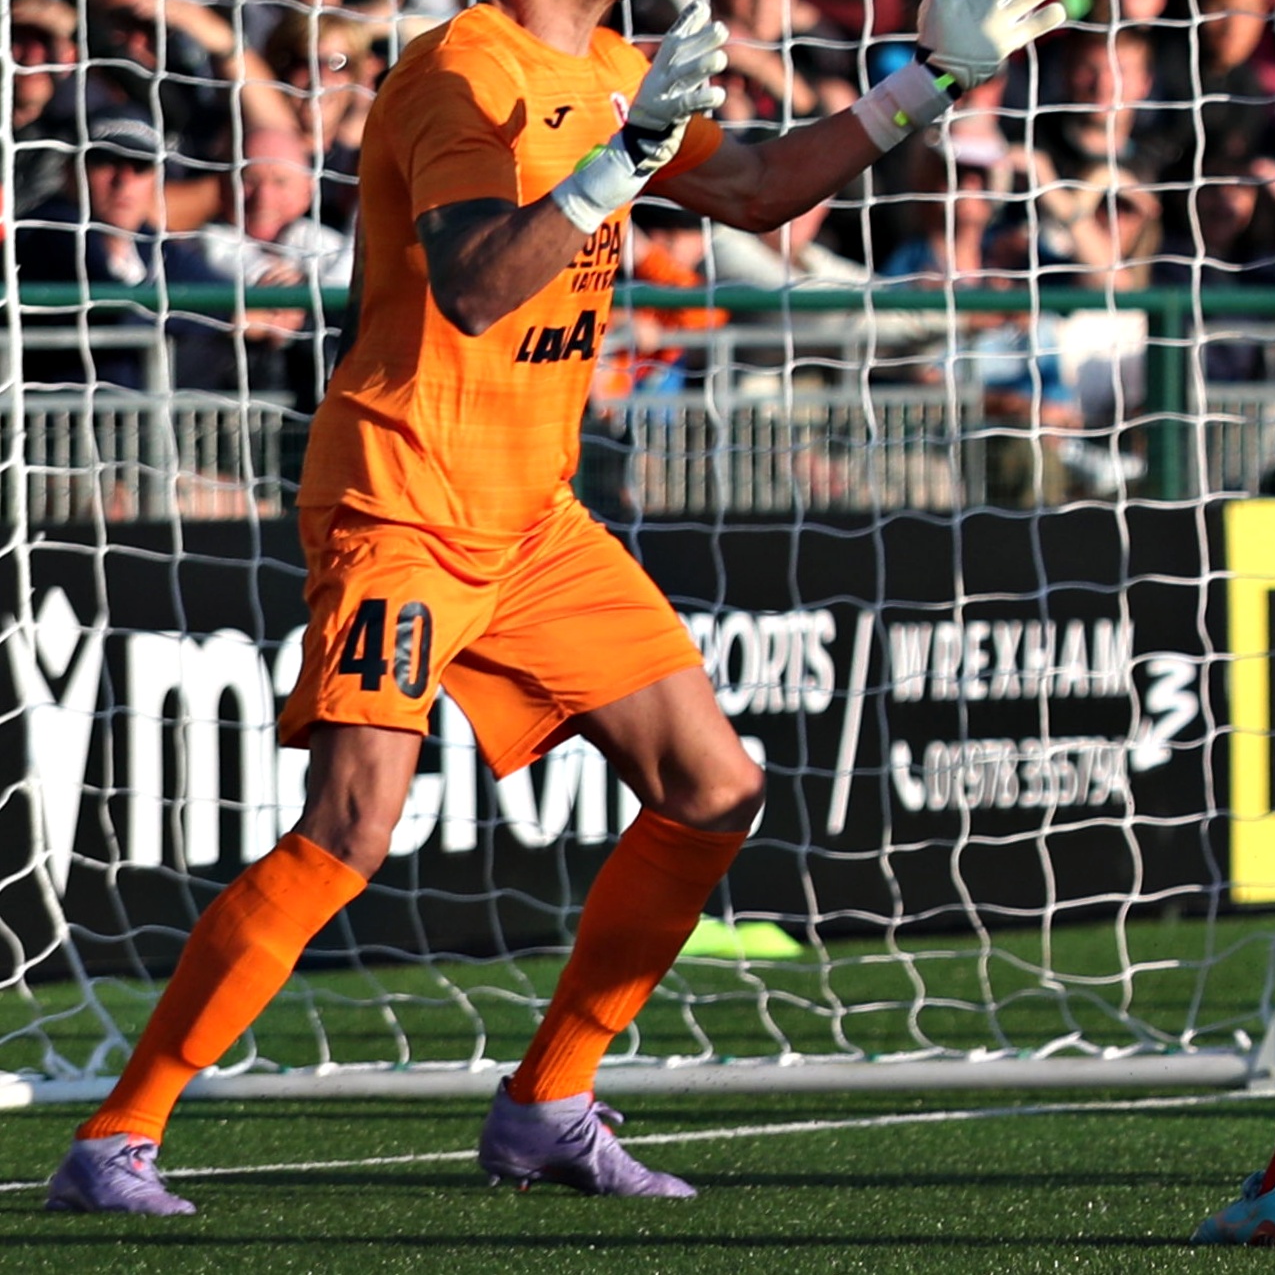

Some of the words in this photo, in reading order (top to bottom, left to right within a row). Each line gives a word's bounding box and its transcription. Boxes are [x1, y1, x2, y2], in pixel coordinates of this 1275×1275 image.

[338, 598, 432, 700] 40
[682, 609, 837, 717] PORTS
[889, 620, 1134, 703] WREXHAM
